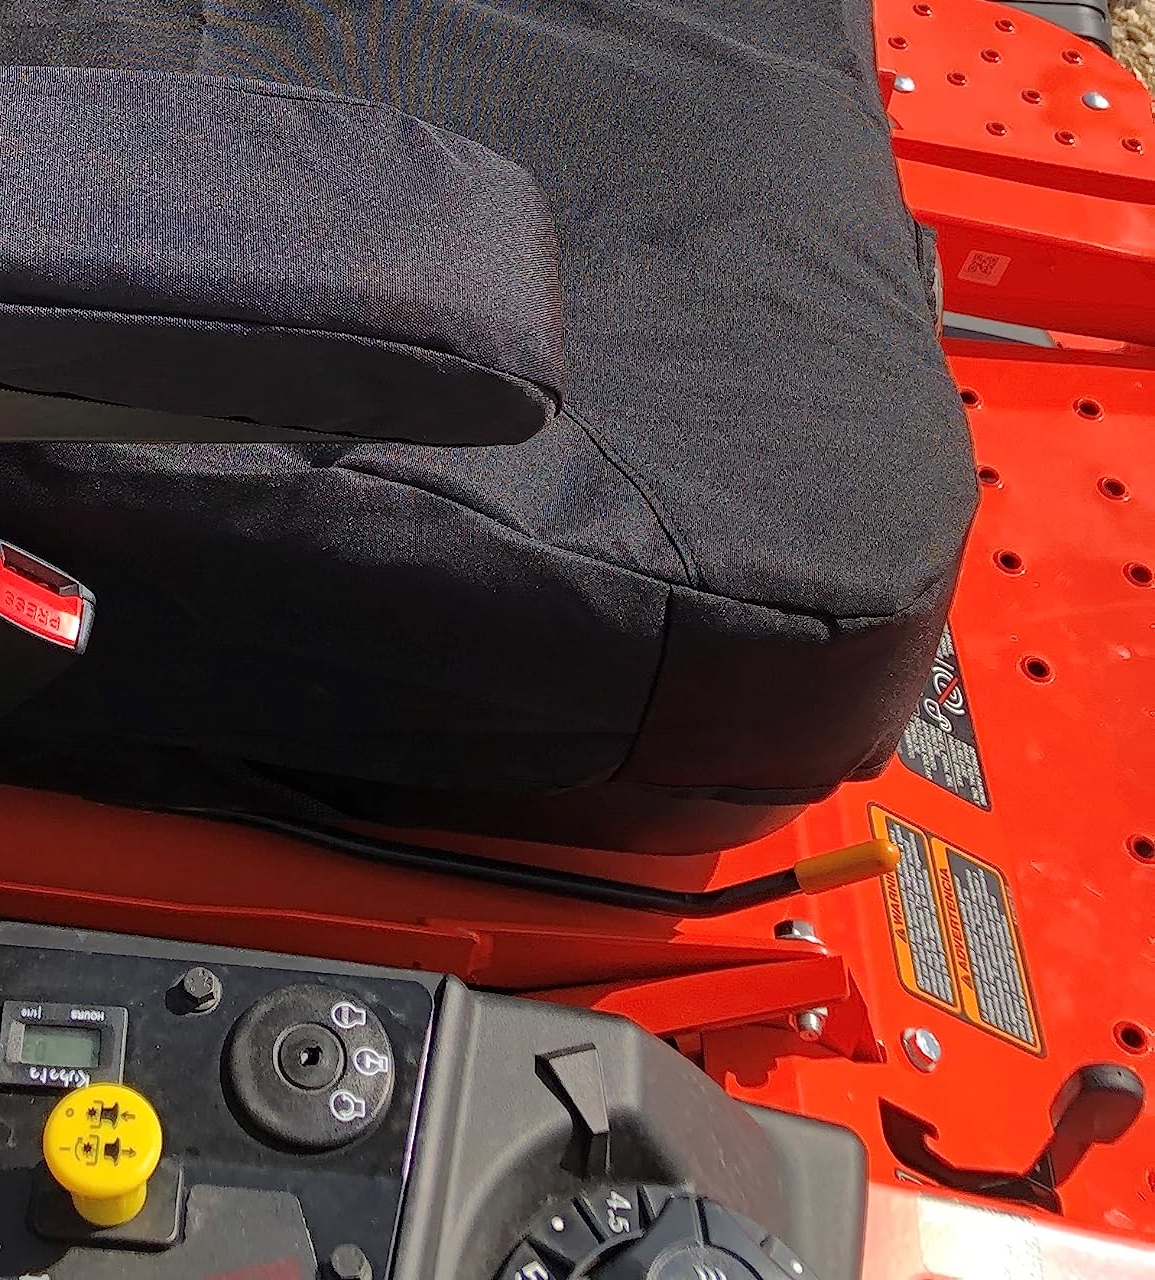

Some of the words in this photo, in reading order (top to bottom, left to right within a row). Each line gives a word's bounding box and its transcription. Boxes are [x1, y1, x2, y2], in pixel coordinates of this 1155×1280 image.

[4, 591, 60, 630] PRESS
[881, 871, 906, 932] WARNI
[940, 869, 971, 977] ADVERTENCIA
[70, 1009, 105, 1021] HOURS
[30, 1067, 90, 1088] Kubota
